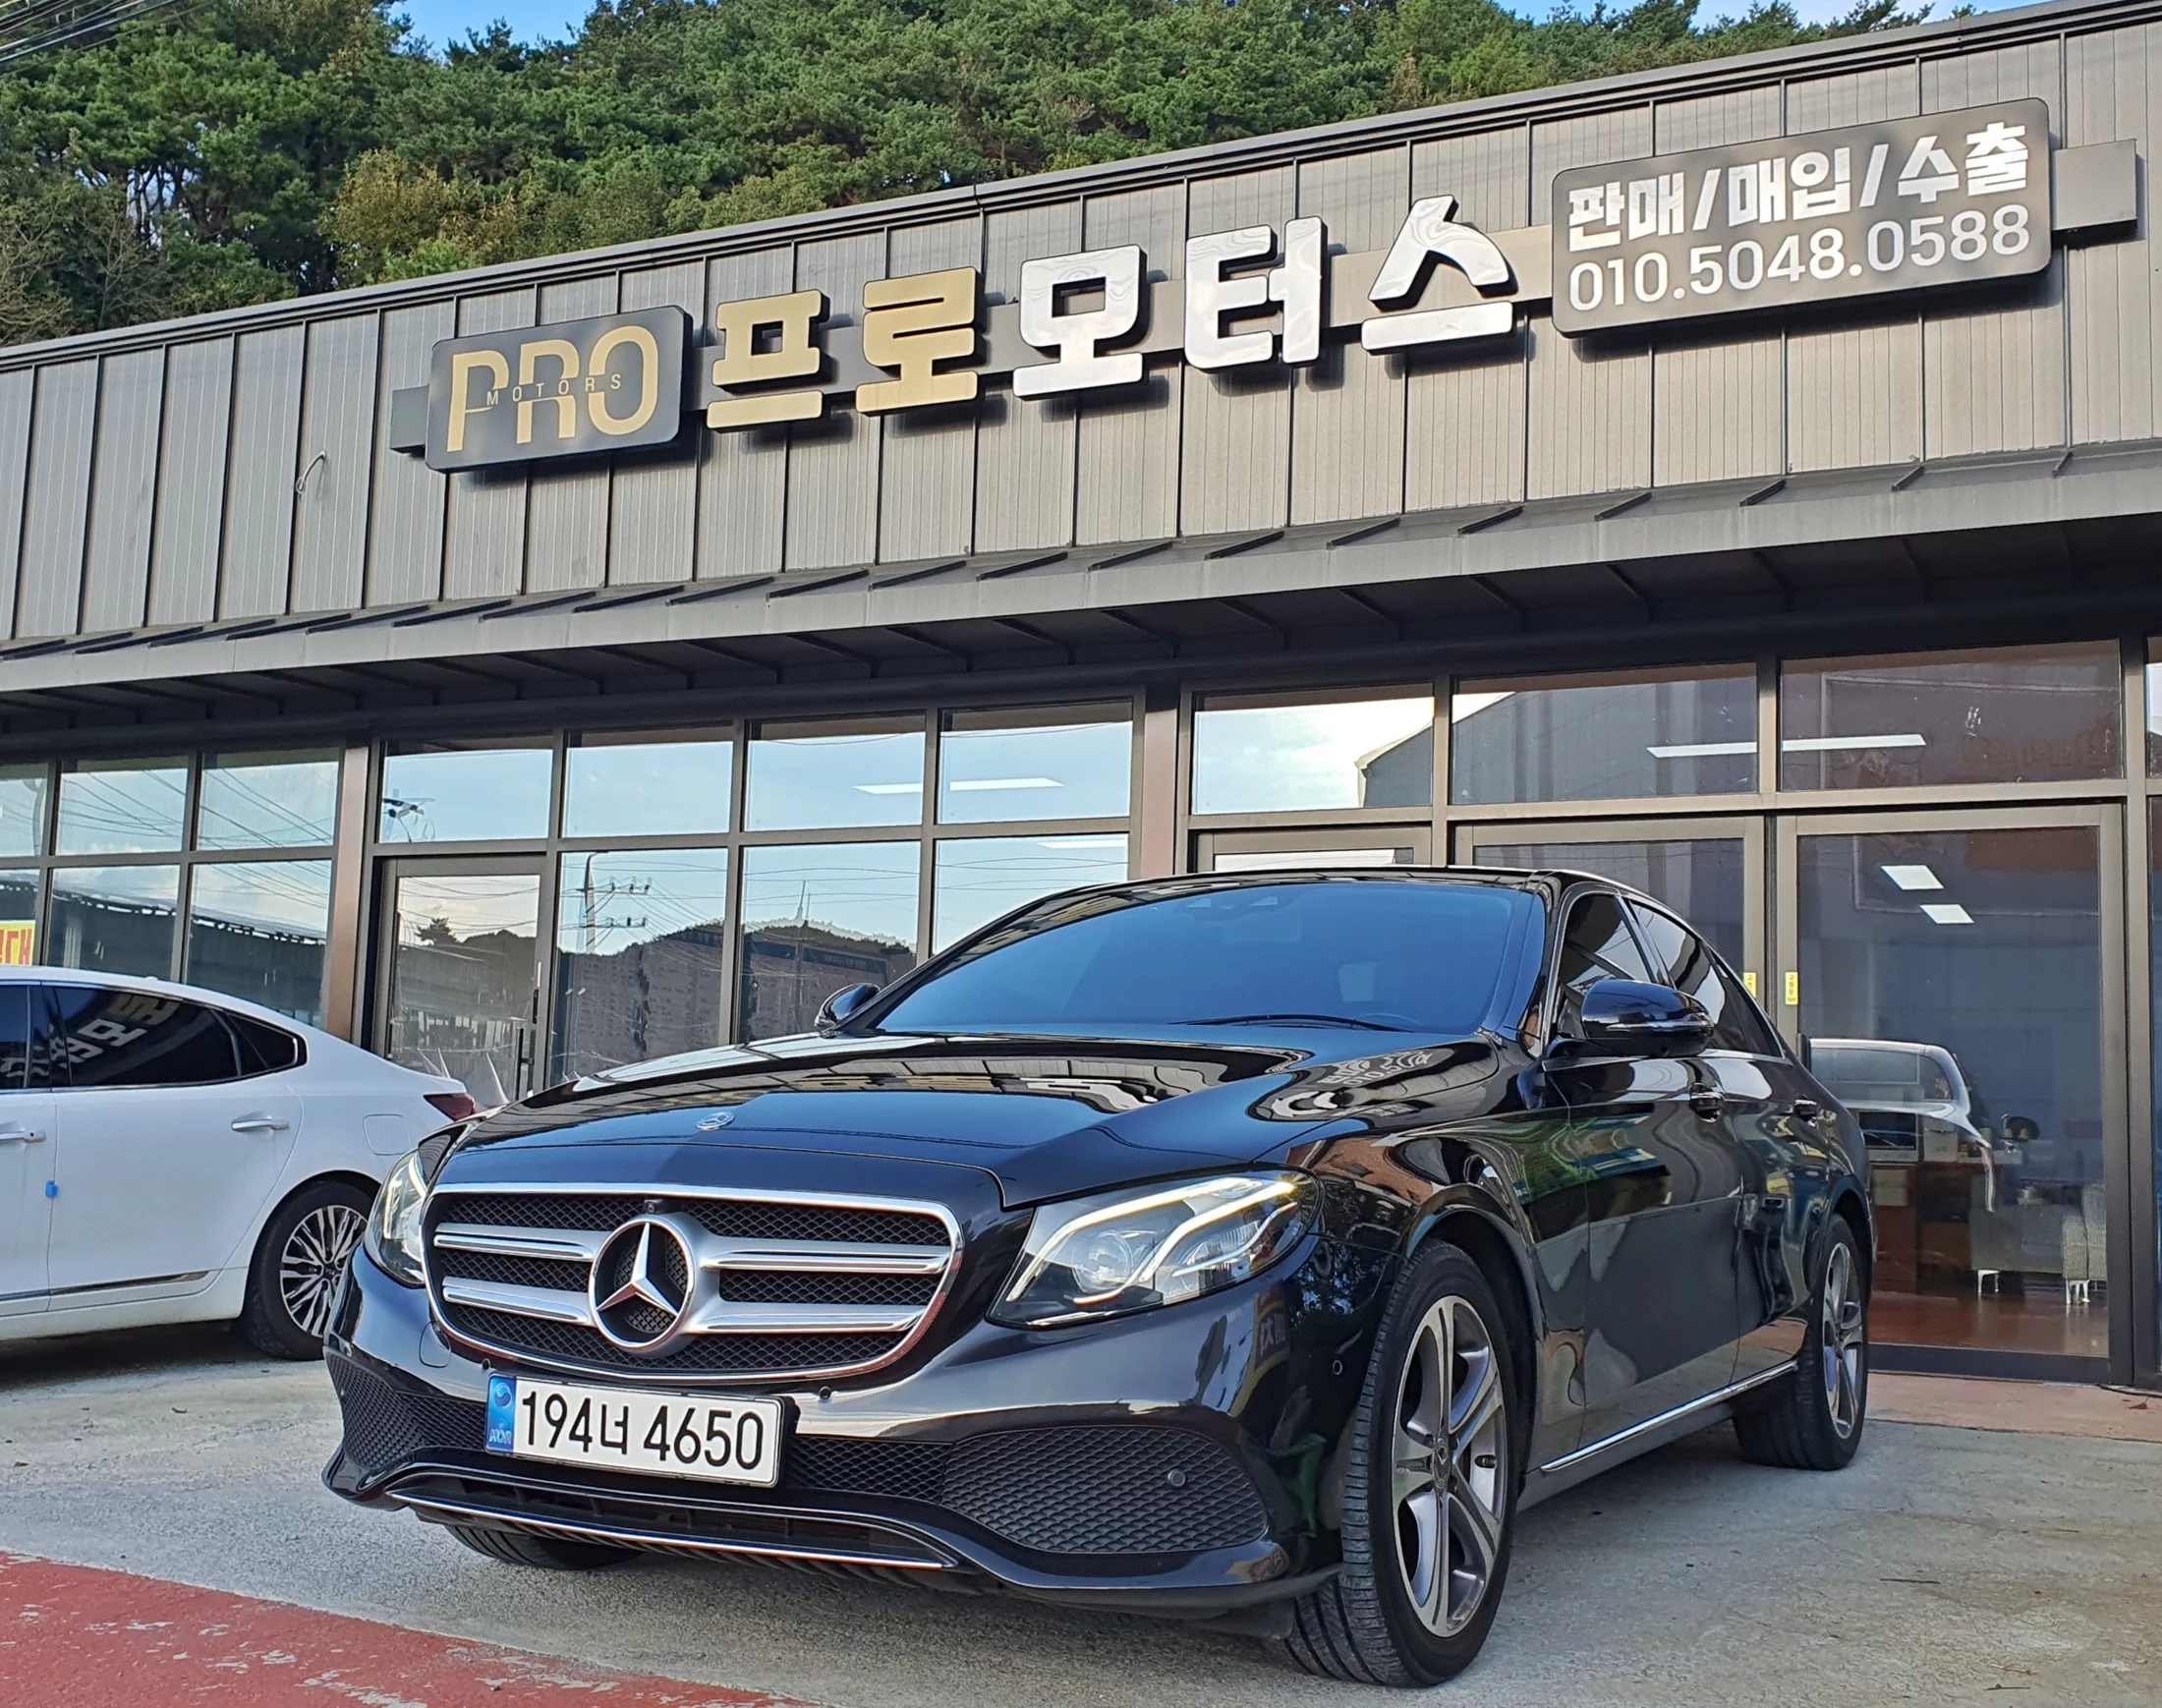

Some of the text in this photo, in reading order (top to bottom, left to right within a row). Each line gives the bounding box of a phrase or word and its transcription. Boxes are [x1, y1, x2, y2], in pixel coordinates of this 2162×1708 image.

[1568, 122, 2028, 253] 판매/매입/수출
[1570, 203, 2031, 312] 010.5048.0588
[706, 195, 1514, 430] 프로모터스
[446, 325, 659, 452] PRO
[486, 373, 622, 406] MOTORS
[0, 928, 32, 965] 대
[522, 1391, 764, 1470] 194너 4650
